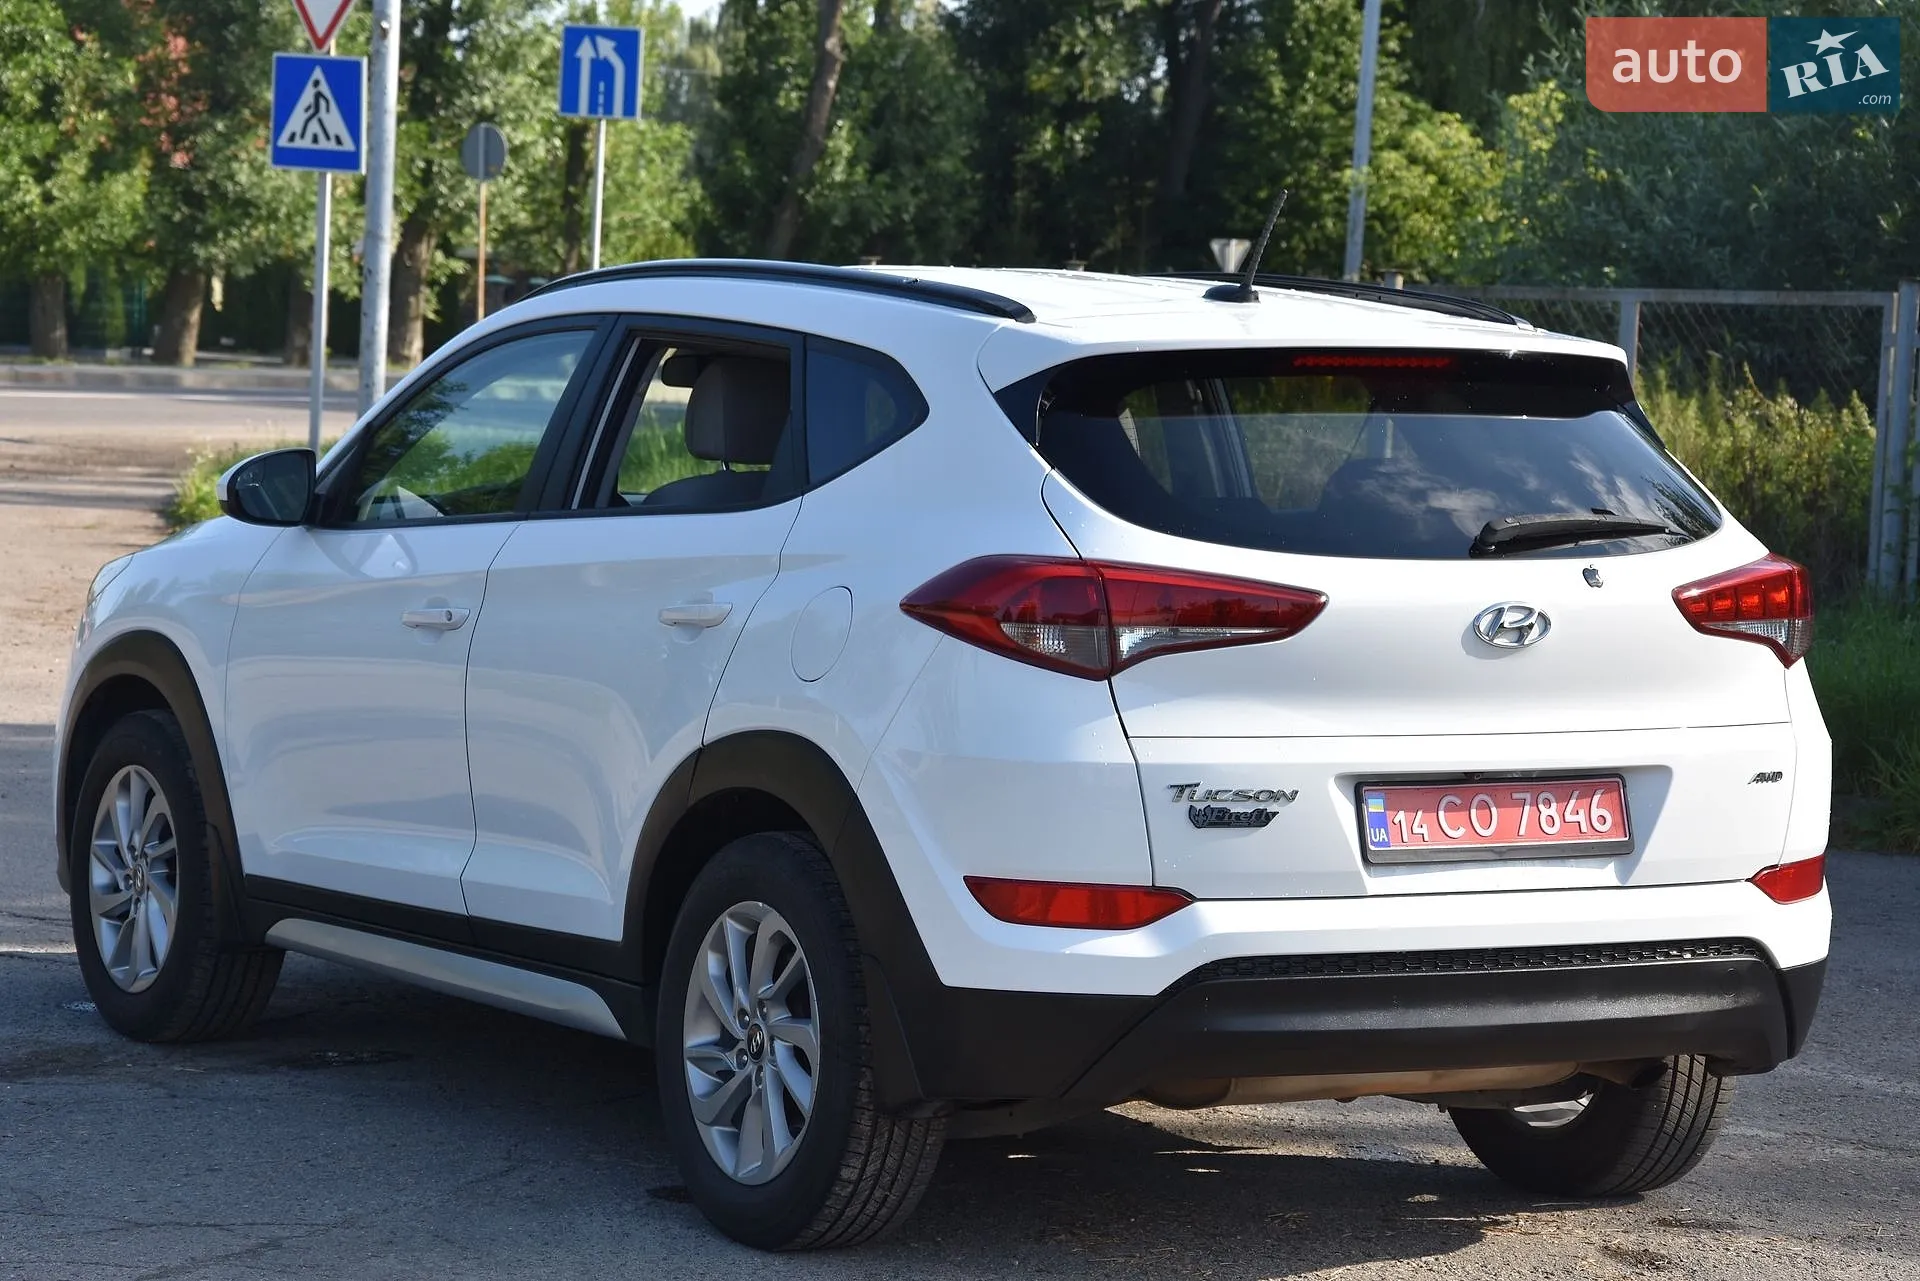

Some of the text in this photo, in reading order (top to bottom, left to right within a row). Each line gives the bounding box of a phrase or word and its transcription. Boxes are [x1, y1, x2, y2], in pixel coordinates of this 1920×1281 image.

[1208, 807, 1279, 823] Firefly
[1392, 789, 1613, 843] 14 CO 7846
[1371, 828, 1388, 843] UA
